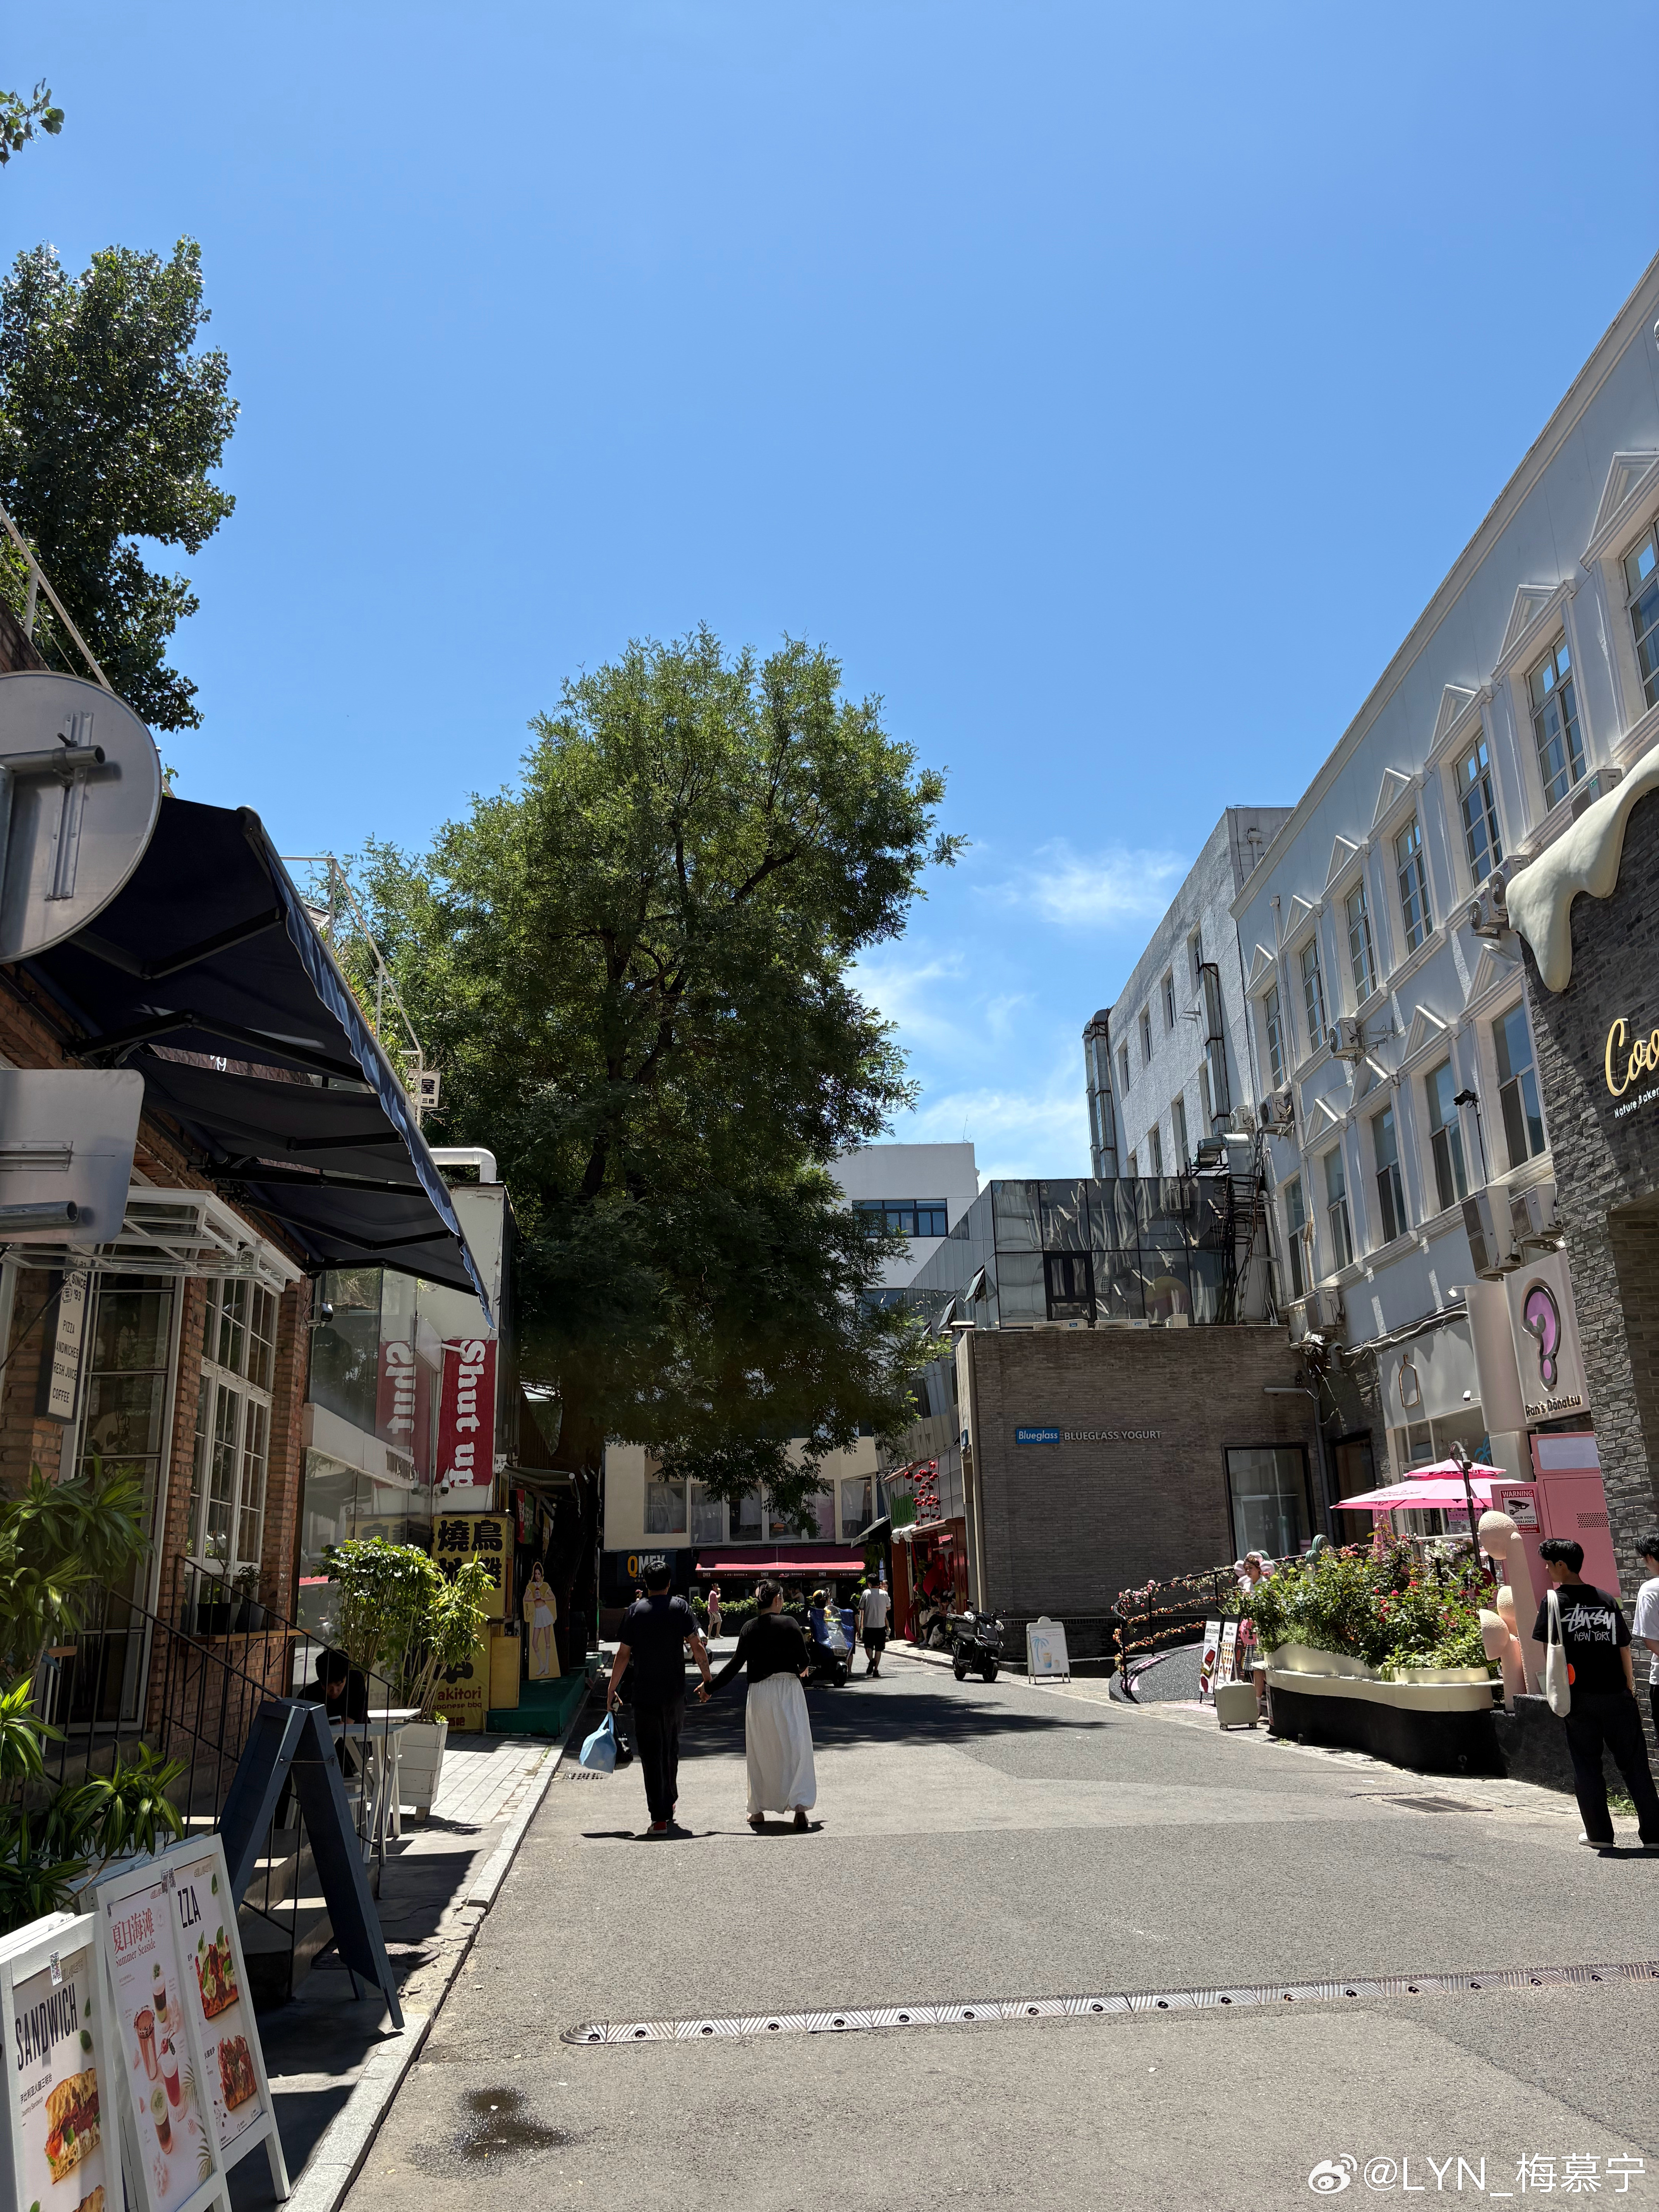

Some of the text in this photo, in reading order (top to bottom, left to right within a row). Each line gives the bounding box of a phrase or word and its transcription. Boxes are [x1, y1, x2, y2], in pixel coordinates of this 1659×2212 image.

[1614, 1100, 1638, 1118] Nature
[72, 1274, 87, 1290] SINCE
[62, 1320, 75, 1335] PIZZA
[57, 1340, 79, 1358] ANDWICHES
[53, 1362, 65, 1376] RESH
[52, 1387, 70, 1403] COFFEE
[448, 1340, 486, 1488] Shut up
[1018, 1431, 1058, 1441] Blueglass
[1064, 1431, 1161, 1441] BLUEGLASS YOGURT
[438, 1686, 481, 1701] akitori
[177, 1885, 201, 1928] ZZA
[110, 1908, 155, 1955] 夏日海滩
[138, 1938, 156, 1956] Seaside
[15, 1982, 77, 2071] SANDWICH
